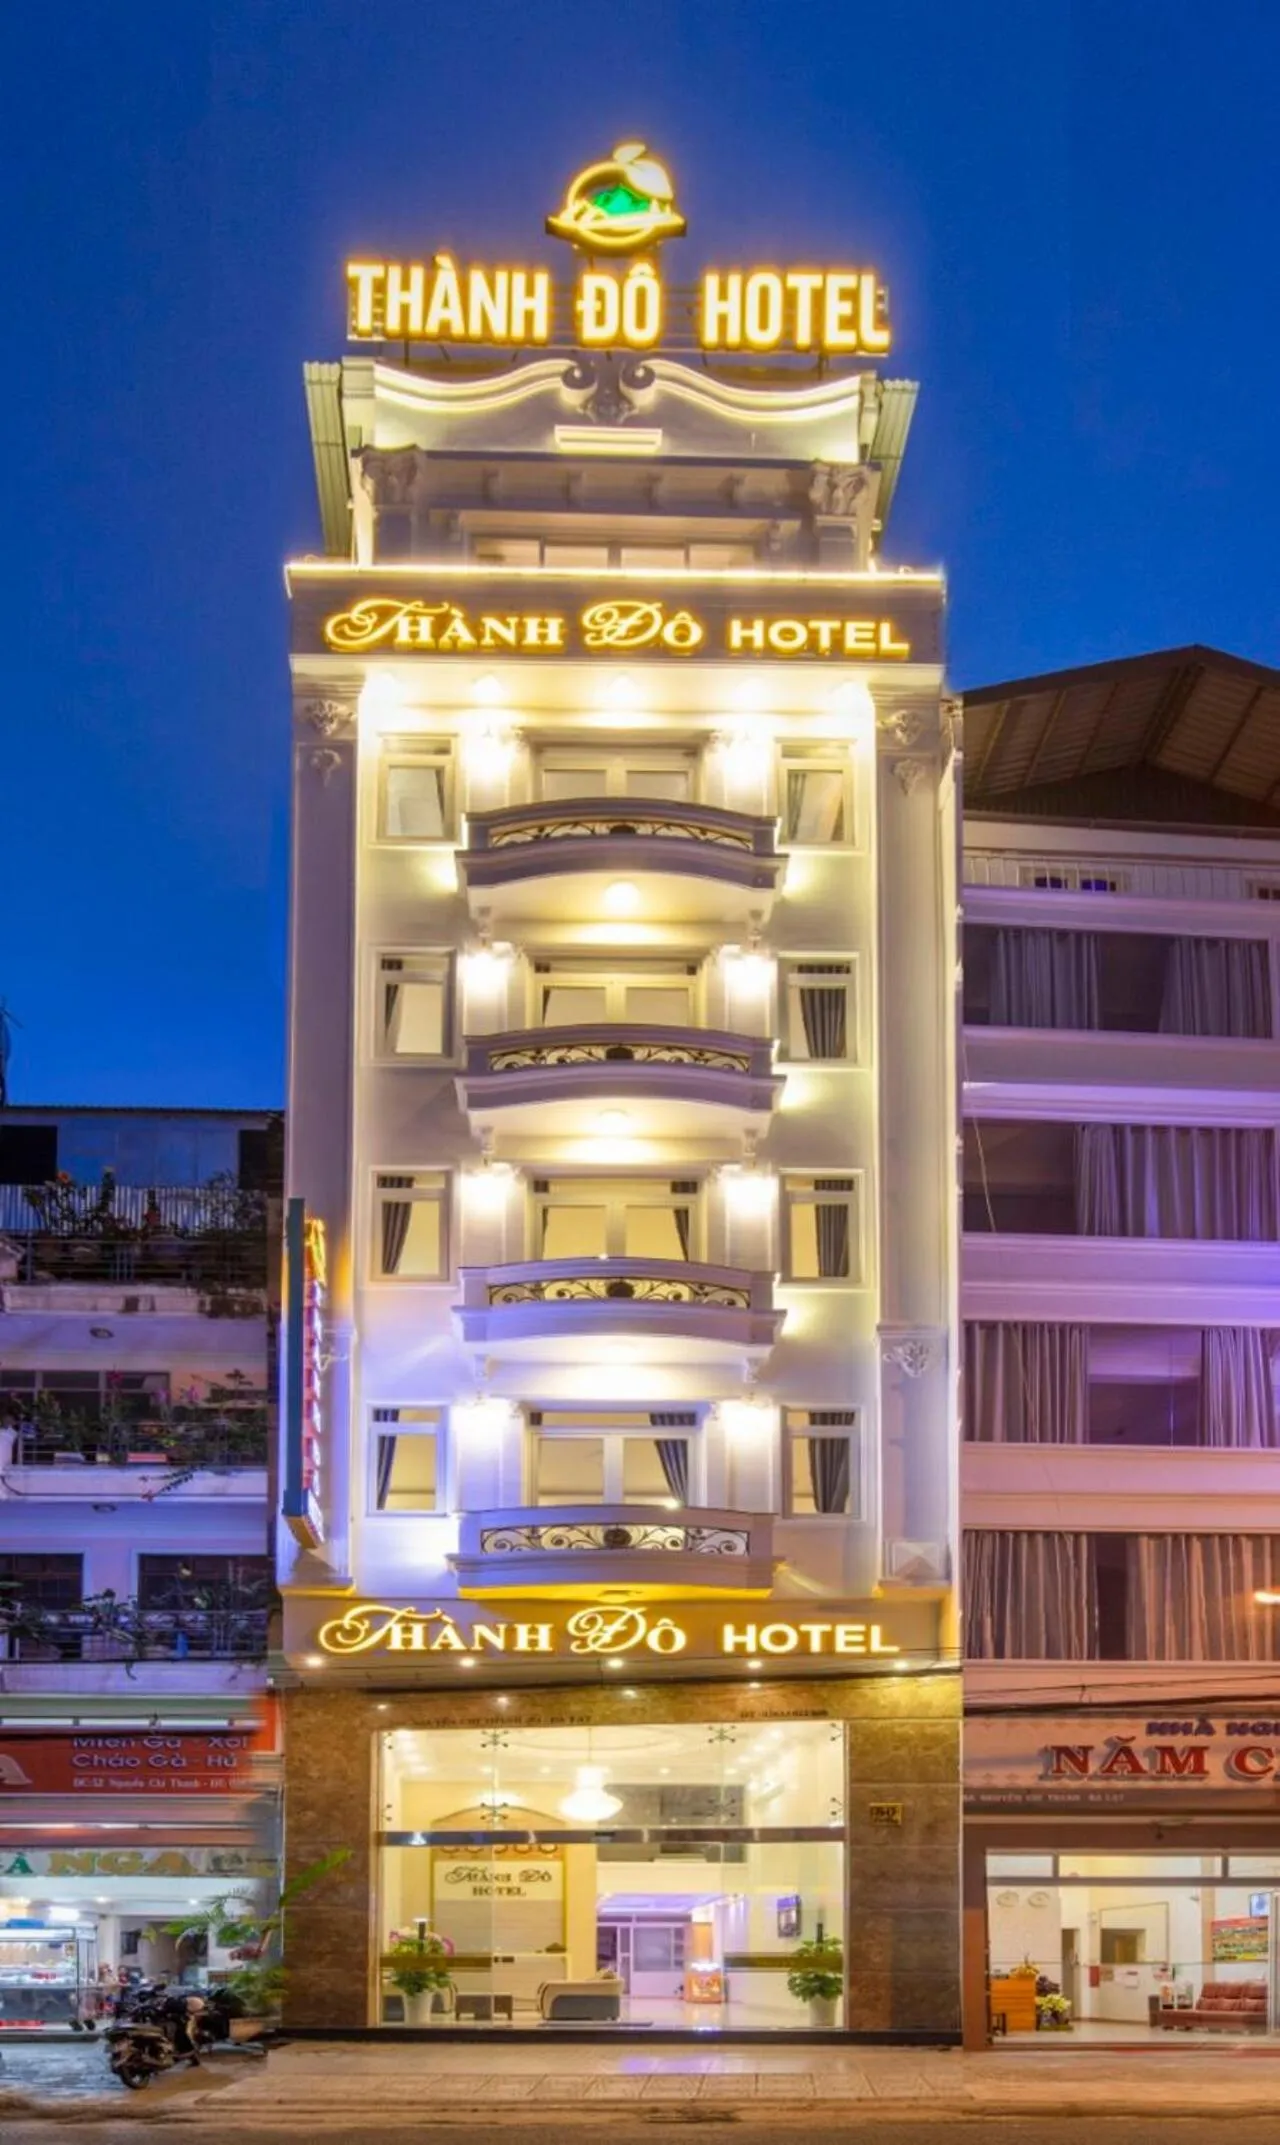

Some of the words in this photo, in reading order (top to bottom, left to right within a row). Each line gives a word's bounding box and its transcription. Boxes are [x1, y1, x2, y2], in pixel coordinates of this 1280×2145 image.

[347, 256, 549, 341] THÀNH
[576, 262, 661, 344] ĐÔ
[705, 273, 890, 347] HOTEL
[730, 619, 910, 652] HOTEL
[723, 1623, 900, 1654] HOTEL
[1048, 1735, 1211, 1777] NĂM
[48, 1851, 199, 1876] NGA
